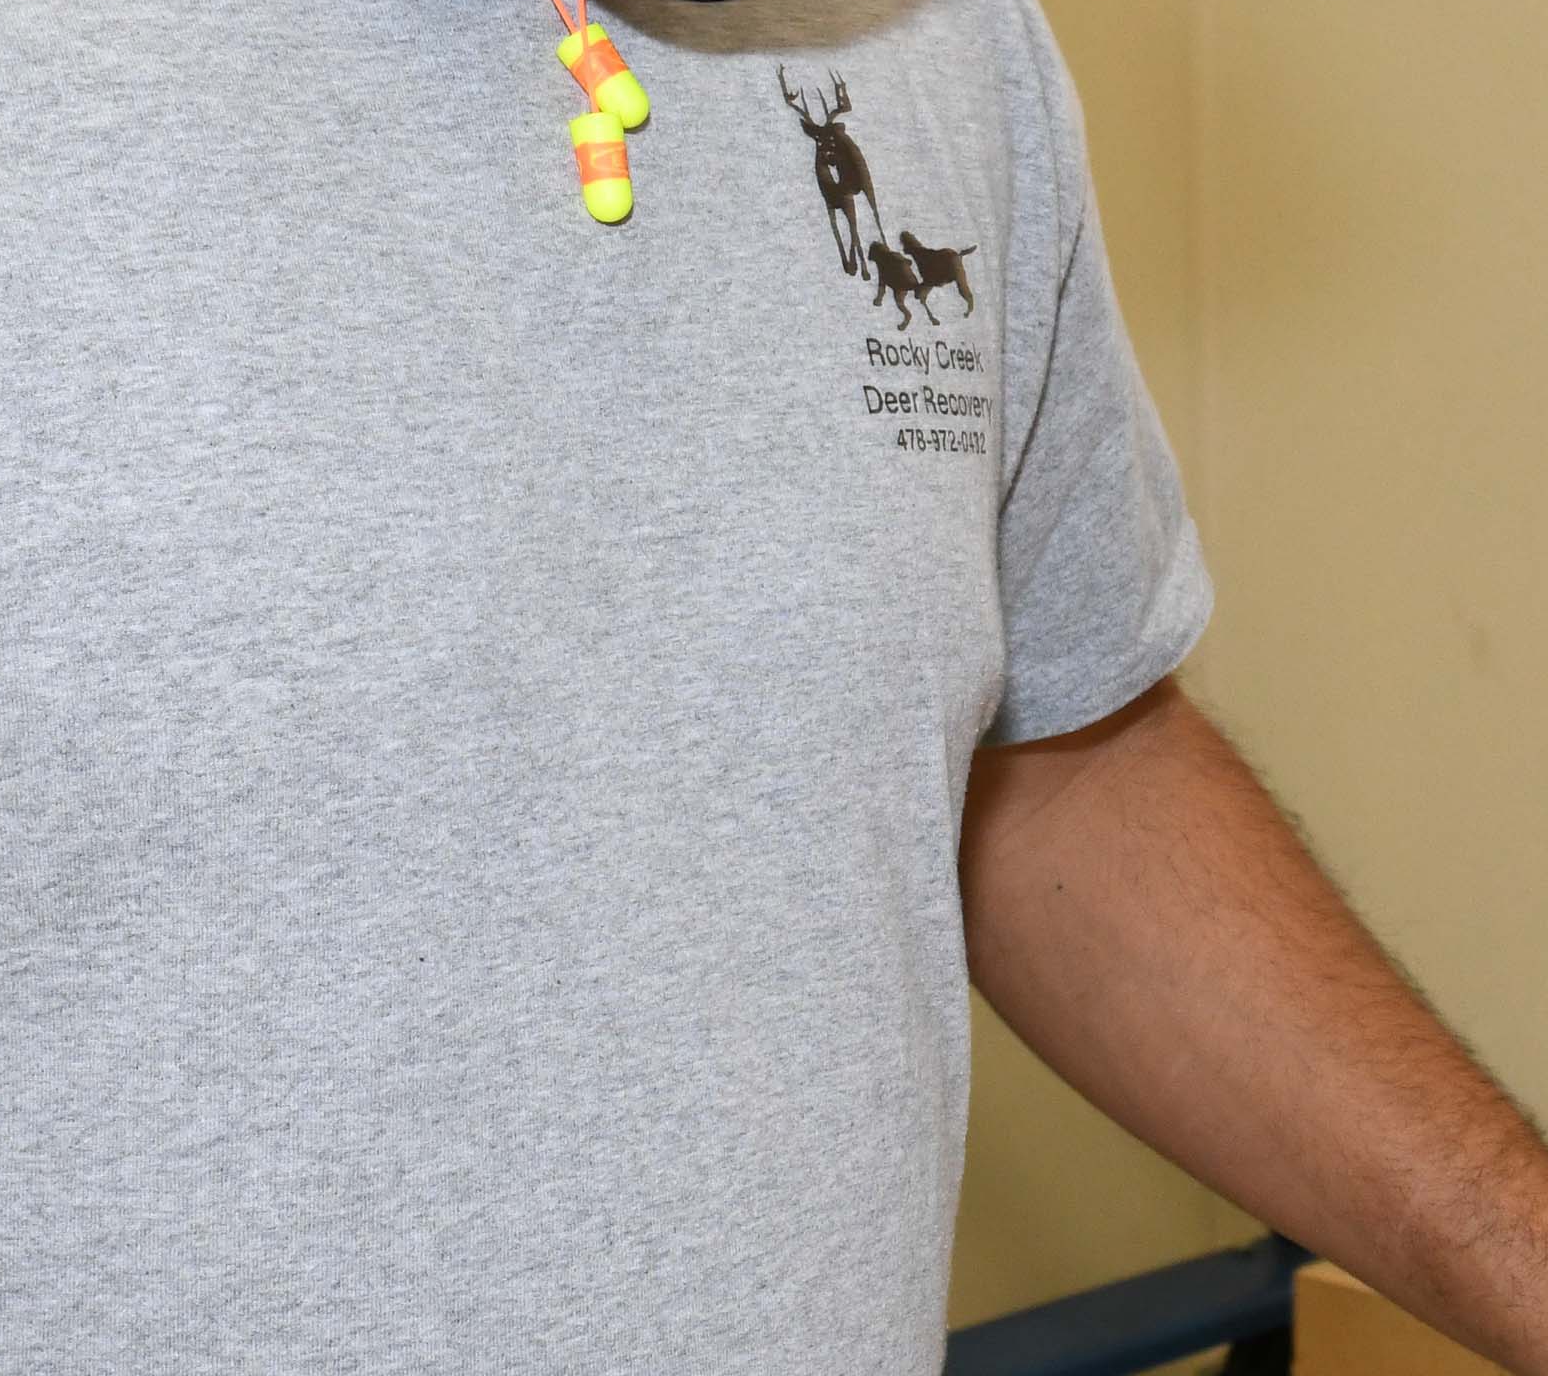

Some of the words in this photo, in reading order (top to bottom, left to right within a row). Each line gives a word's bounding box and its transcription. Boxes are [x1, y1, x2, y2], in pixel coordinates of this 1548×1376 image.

[866, 337, 930, 375] Rocky
[935, 340, 984, 373] Creek
[863, 385, 918, 414] Deer
[923, 385, 993, 424] Recovery
